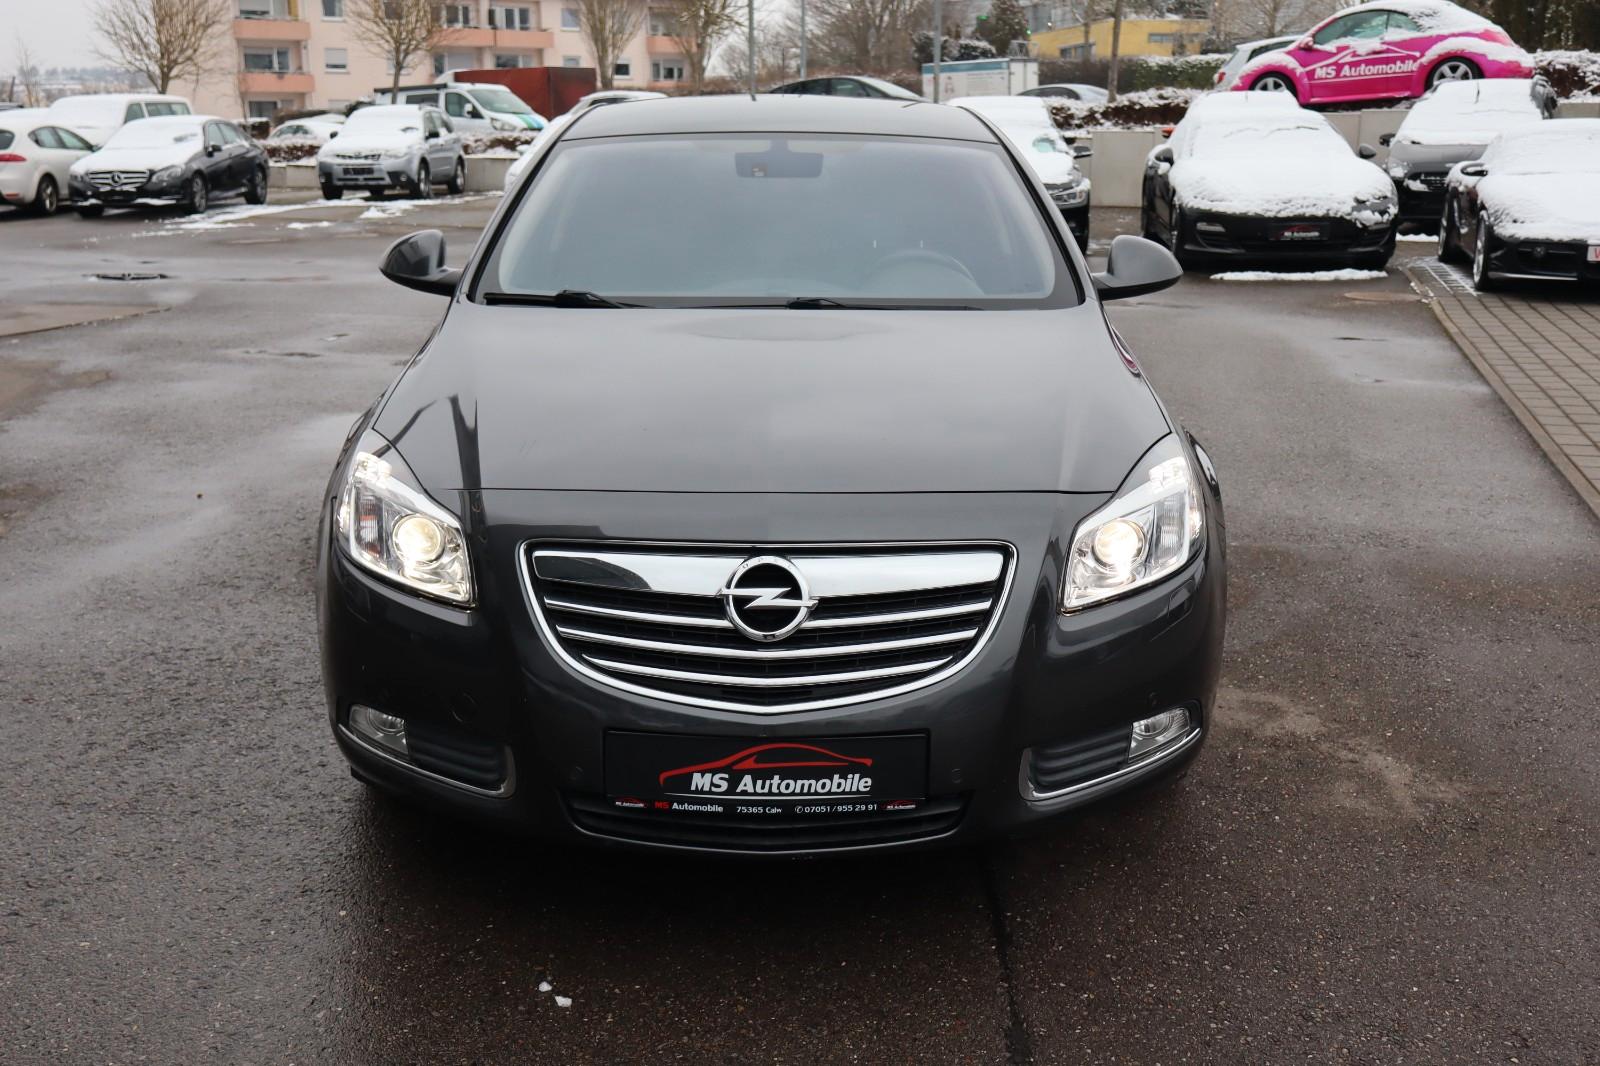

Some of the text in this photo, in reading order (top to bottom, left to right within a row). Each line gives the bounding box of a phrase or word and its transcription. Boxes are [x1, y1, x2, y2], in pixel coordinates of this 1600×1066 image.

[1314, 66, 1337, 79] MS
[690, 772, 872, 793] MS Automobile
[655, 801, 669, 809] MS
[672, 802, 723, 812] Automobile
[736, 806, 763, 814] 75365
[765, 806, 782, 814] Calw
[868, 803, 877, 811] 91
